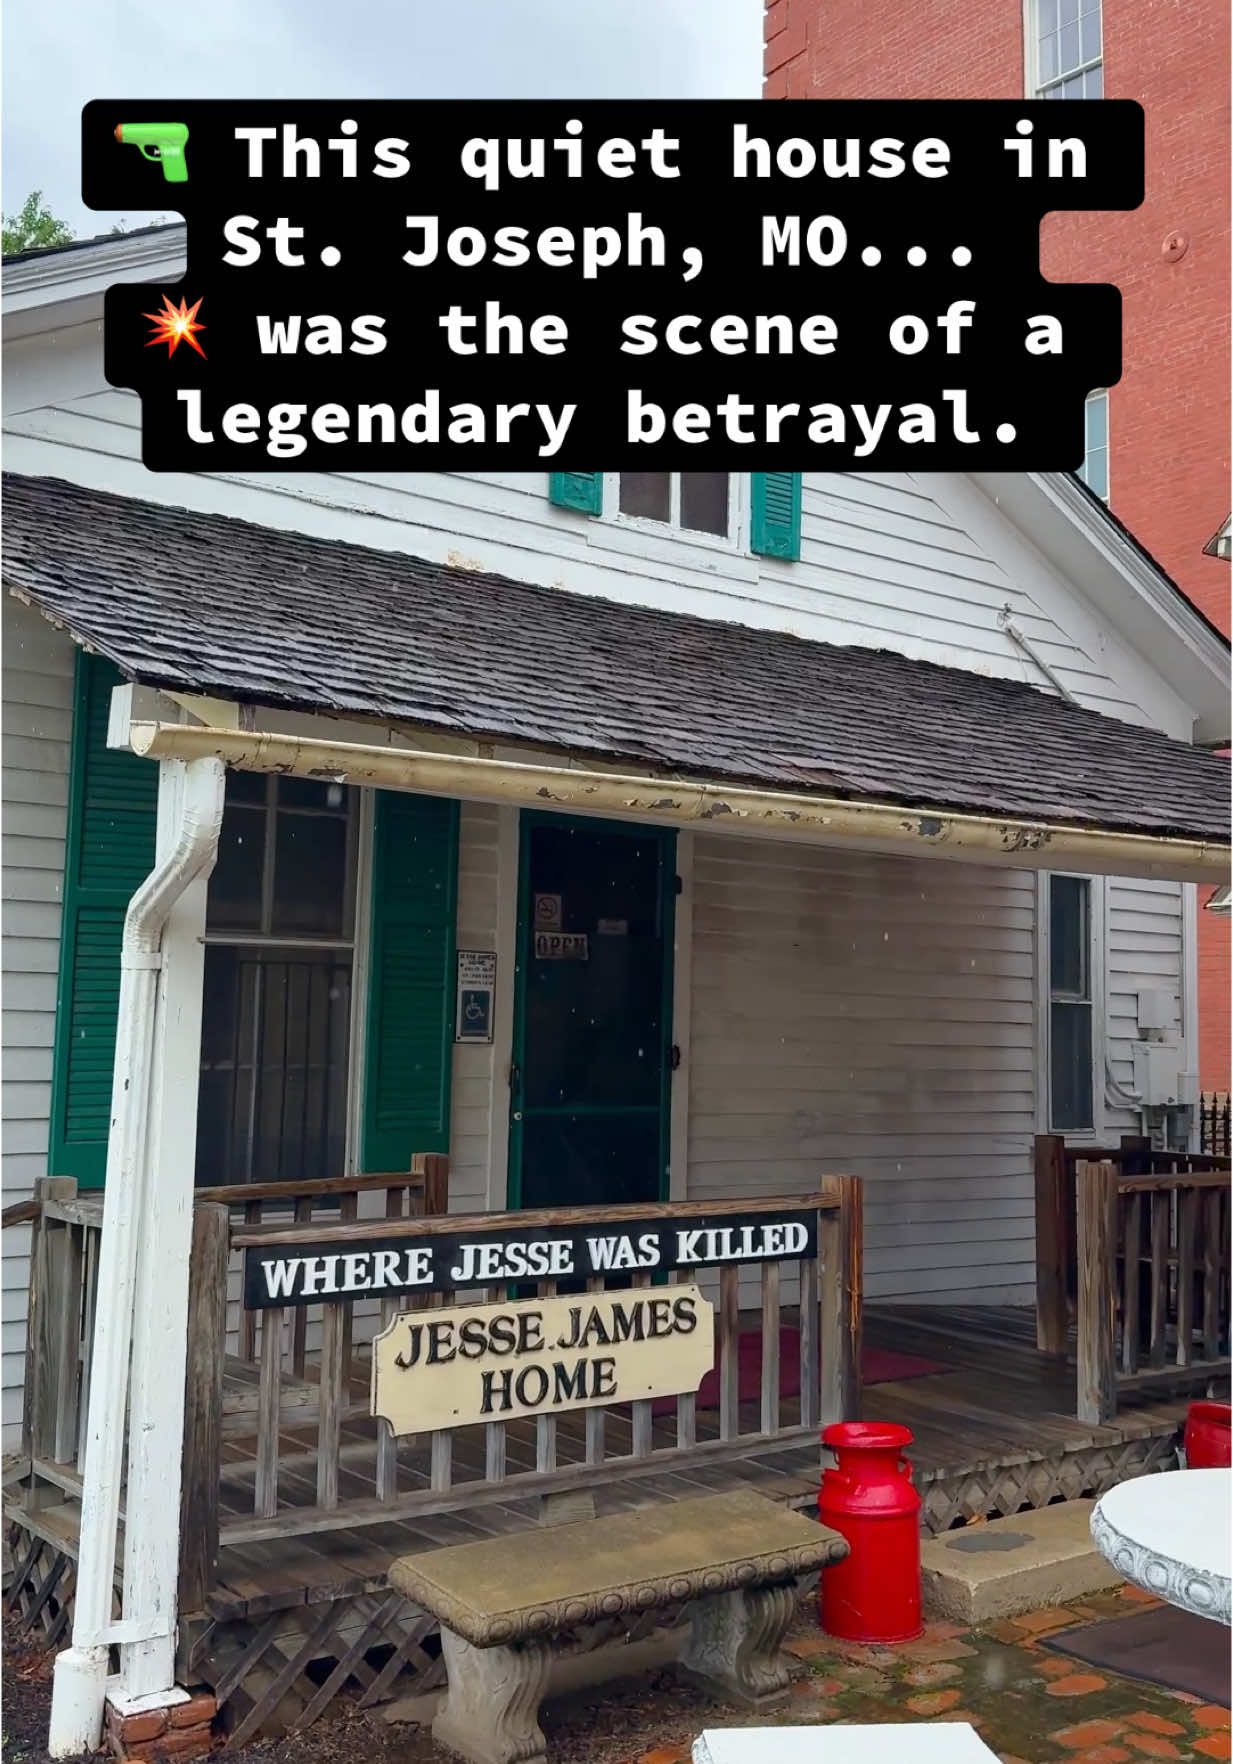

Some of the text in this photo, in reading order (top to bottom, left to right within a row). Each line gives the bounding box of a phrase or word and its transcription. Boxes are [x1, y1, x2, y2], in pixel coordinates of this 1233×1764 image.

[538, 936, 585, 957] OPEN
[261, 1222, 809, 1299] WHERE JESSE WAS KILLED
[394, 1297, 698, 1369] JESSE JAMES
[480, 1358, 618, 1414] HOME
